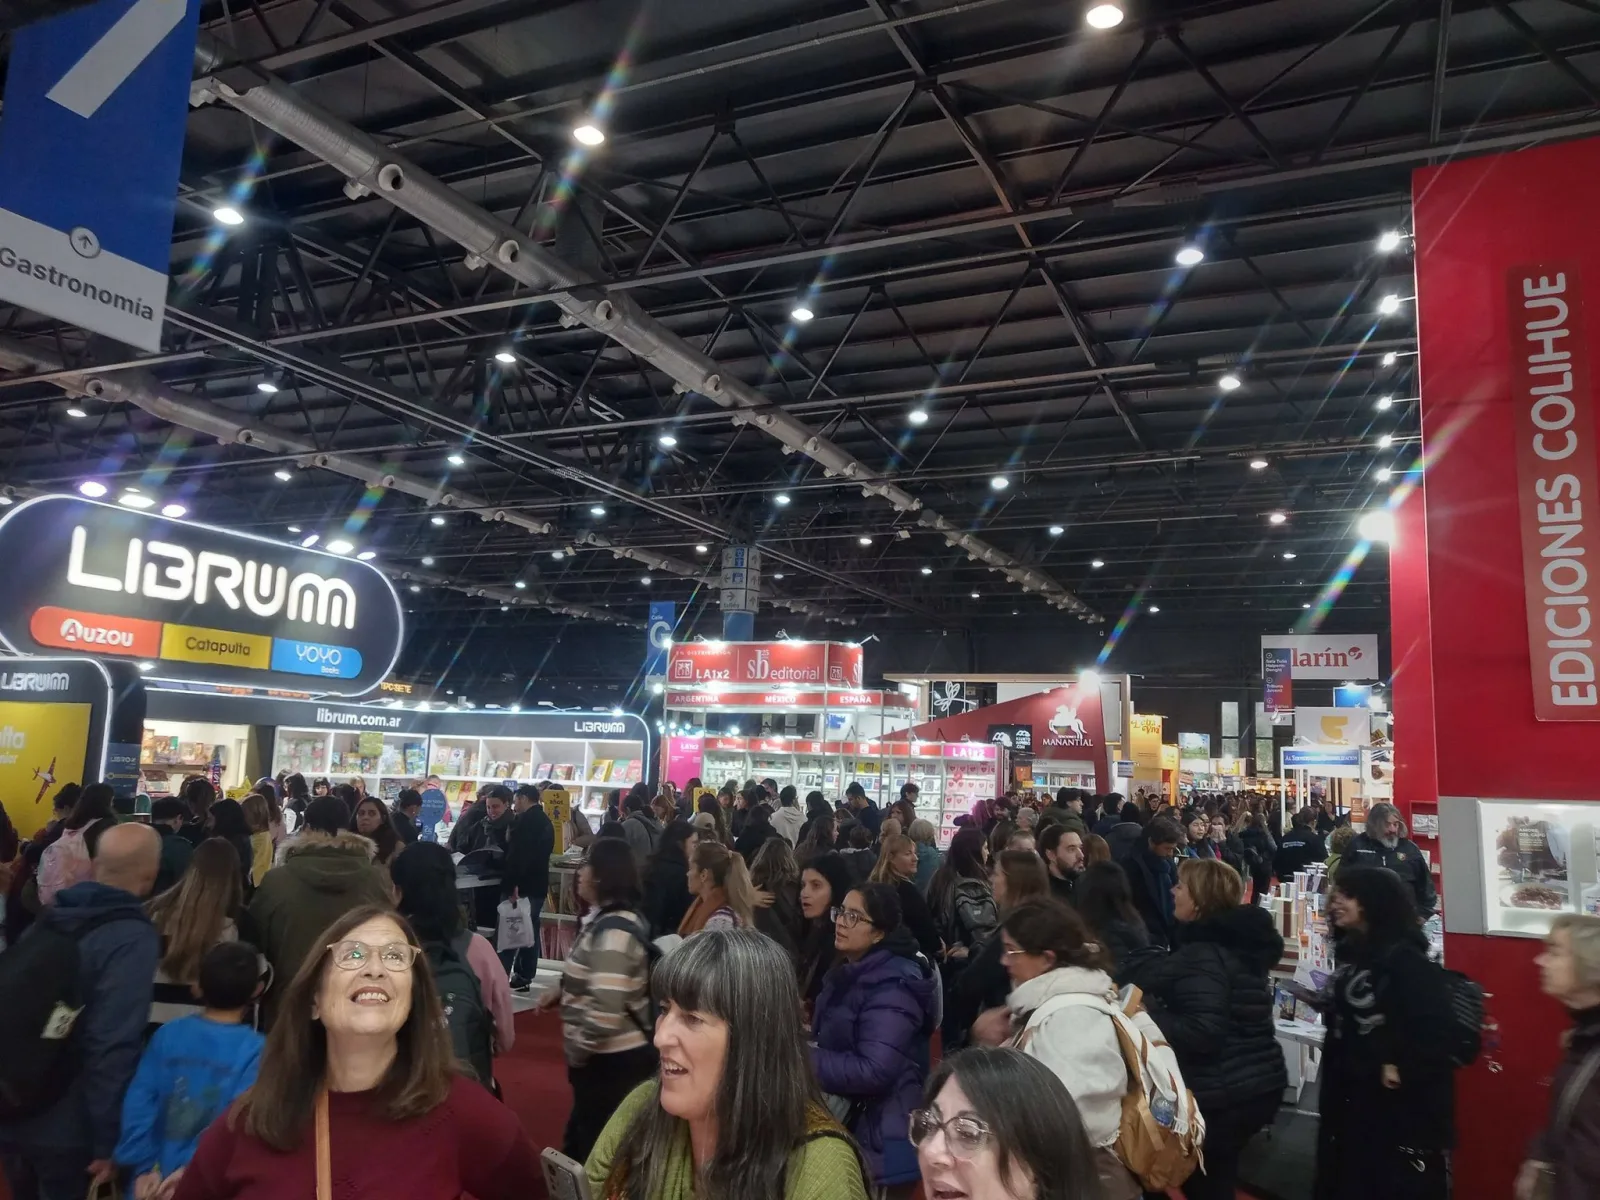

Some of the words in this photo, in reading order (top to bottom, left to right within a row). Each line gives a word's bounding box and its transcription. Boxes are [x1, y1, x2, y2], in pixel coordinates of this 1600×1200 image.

[1523, 272, 1578, 460] COLIHUE
[67, 525, 356, 629] LIBRUM
[1534, 474, 1598, 706] EDICIONES
[185, 636, 251, 657] Catapulta
[1292, 647, 1349, 667] larín
[770, 666, 820, 680] editorial
[839, 694, 873, 704] ESPAÑA
[316, 707, 402, 728] librum.com.ar
[1042, 738, 1094, 747] MANANTIAL
